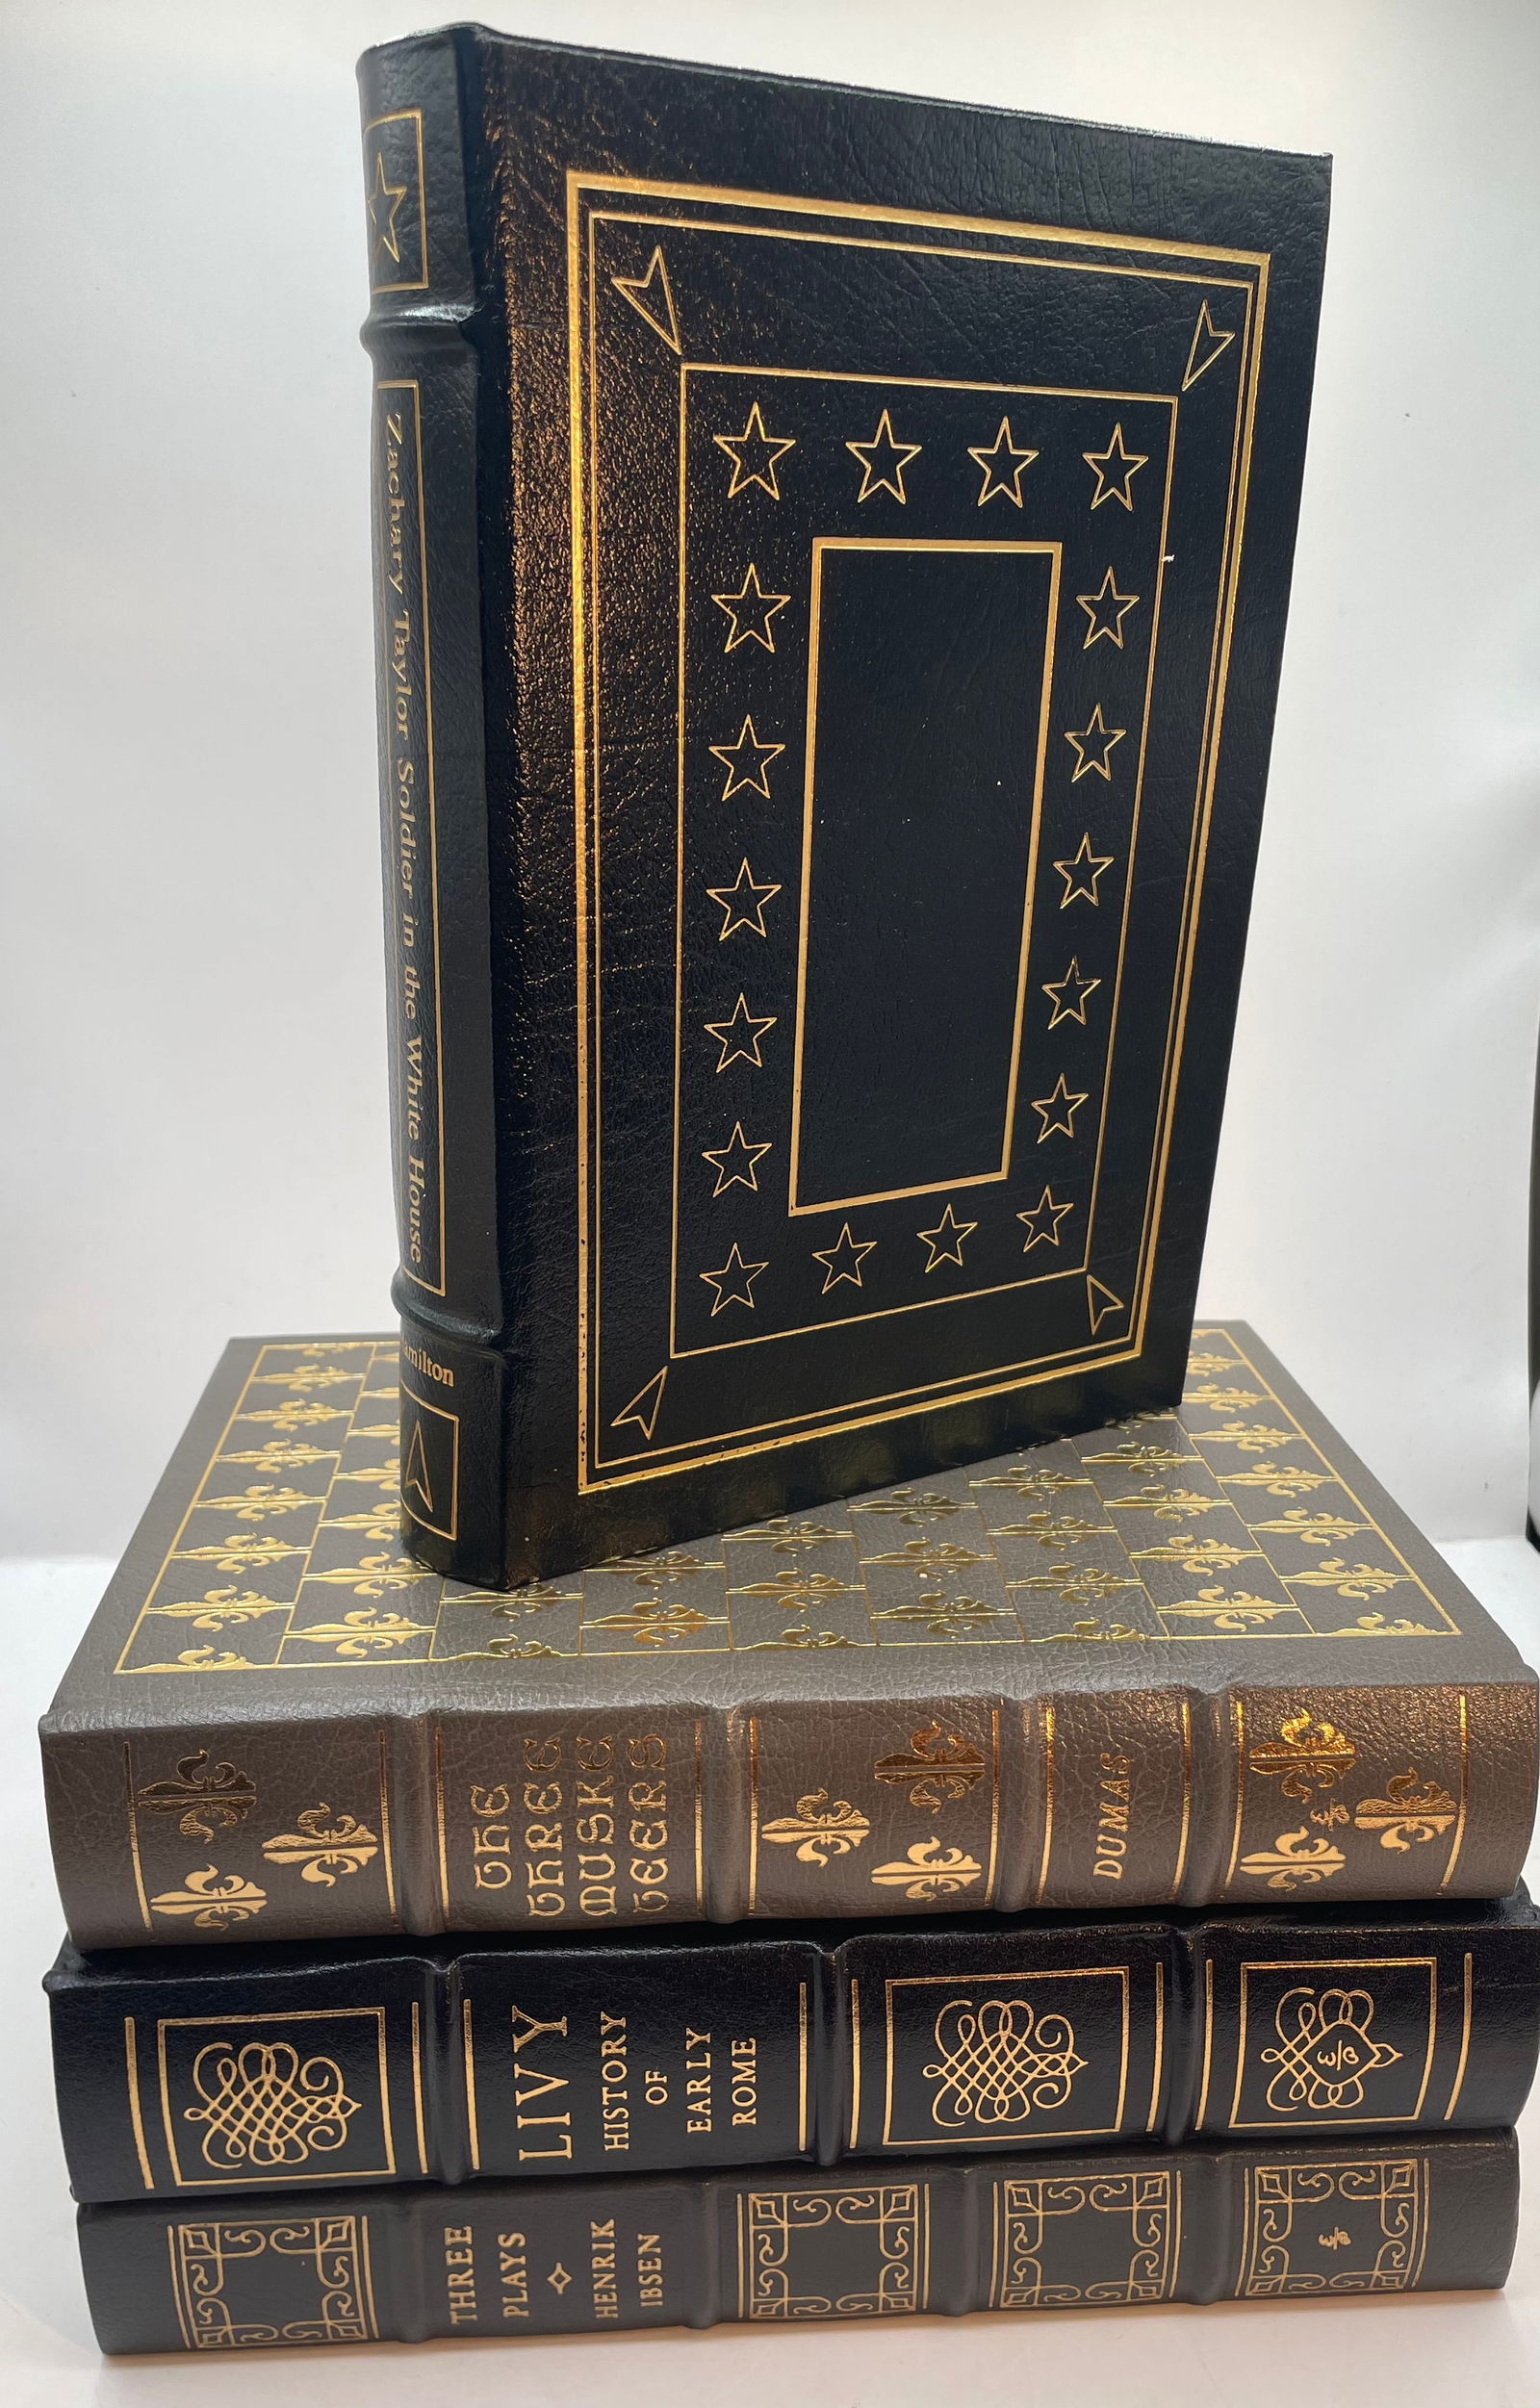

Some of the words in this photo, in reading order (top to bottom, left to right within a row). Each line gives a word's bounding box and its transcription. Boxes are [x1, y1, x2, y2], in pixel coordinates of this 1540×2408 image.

[386, 411, 405, 596] Zachary
[392, 608, 413, 741] Taylor
[398, 757, 417, 900] Soldier
[402, 912, 421, 949] in
[404, 963, 422, 1020] the
[406, 1036, 424, 1141] White
[408, 1155, 425, 1265] House
[1092, 1752, 1131, 1880] DUMAS
[511, 2005, 573, 2162] LIVY
[601, 2011, 630, 2152] HISTORY
[644, 2069, 669, 2106] OF
[685, 2027, 712, 2134] EARLY
[731, 2037, 757, 2127] ROME
[444, 2225, 478, 2325] THREE
[497, 2232, 530, 2318] PLAYS
[589, 2218, 619, 2319] HENRIK
[636, 2233, 664, 2308] IBSEN
